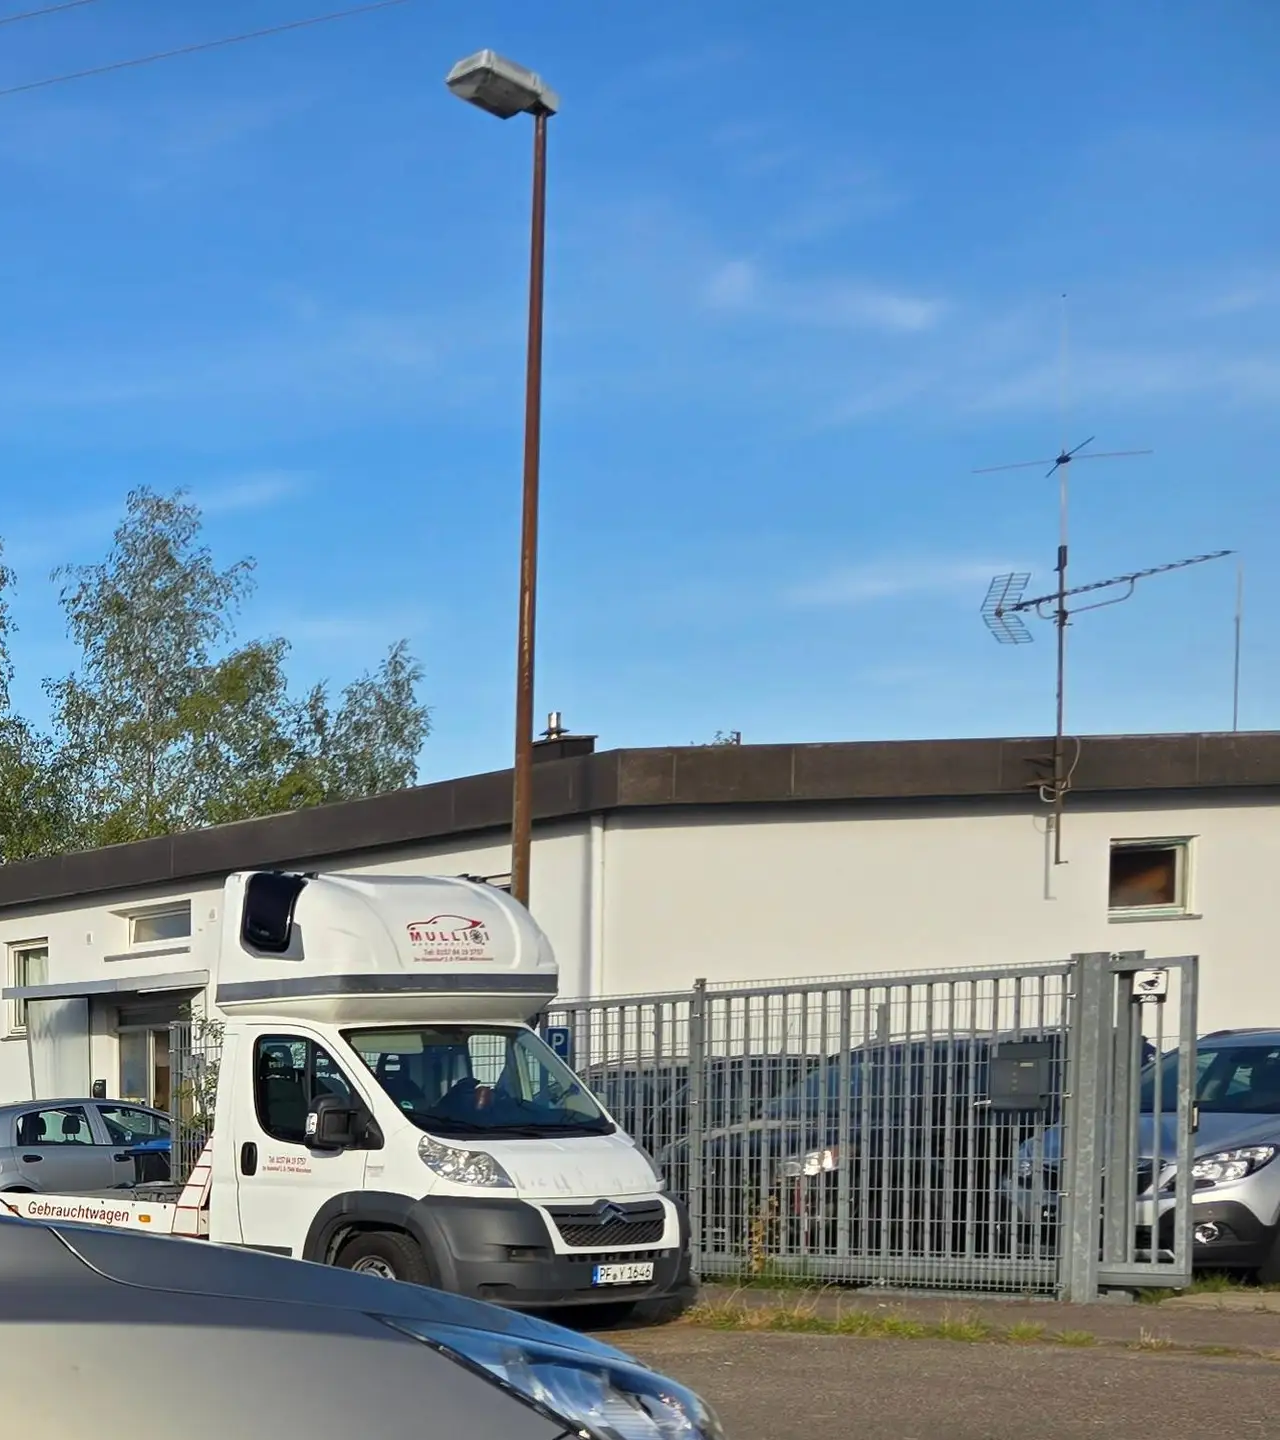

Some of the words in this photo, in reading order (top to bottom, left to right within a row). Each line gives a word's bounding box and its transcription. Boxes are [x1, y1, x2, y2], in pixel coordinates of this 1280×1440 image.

[552, 1033, 565, 1050] P
[28, 1201, 129, 1224] Gebrauchtwagen
[600, 1266, 612, 1280] PF
[627, 1264, 651, 1279] 1646
